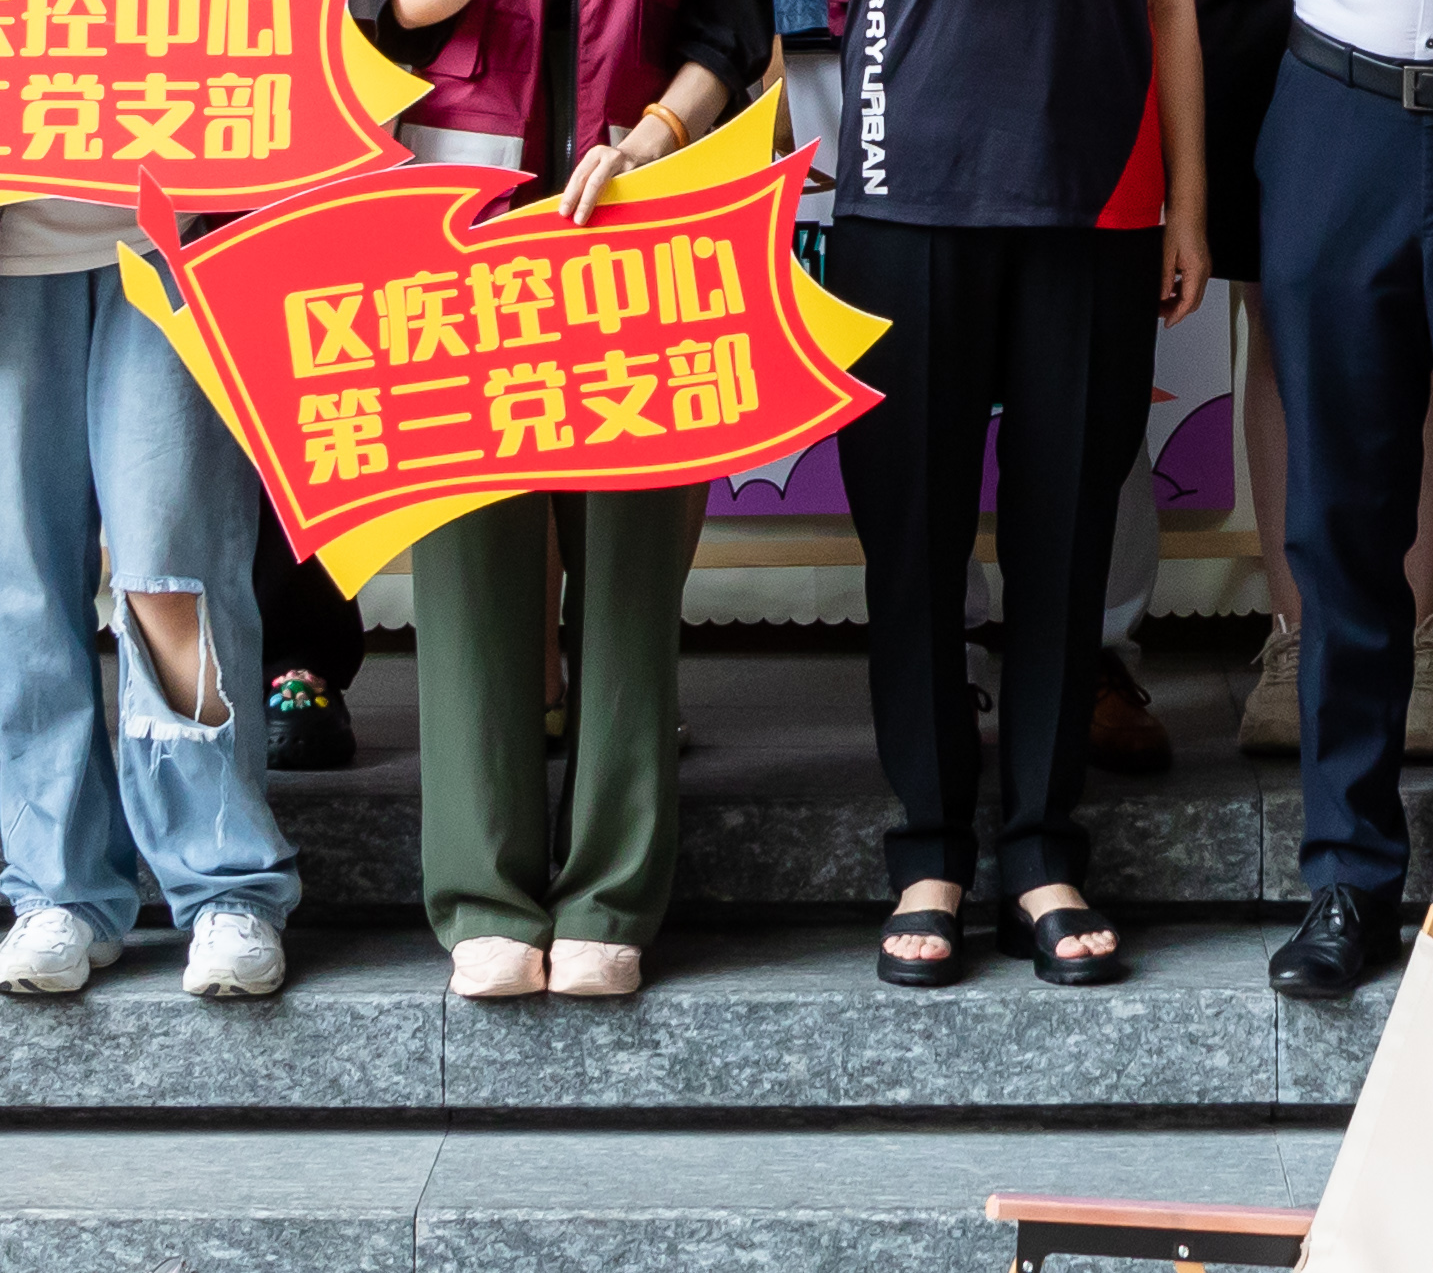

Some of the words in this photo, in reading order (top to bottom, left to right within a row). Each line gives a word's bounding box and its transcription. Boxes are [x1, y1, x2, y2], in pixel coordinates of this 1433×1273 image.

[283, 234, 746, 379] 区疾控中心
[297, 332, 761, 486] 第三党支部
